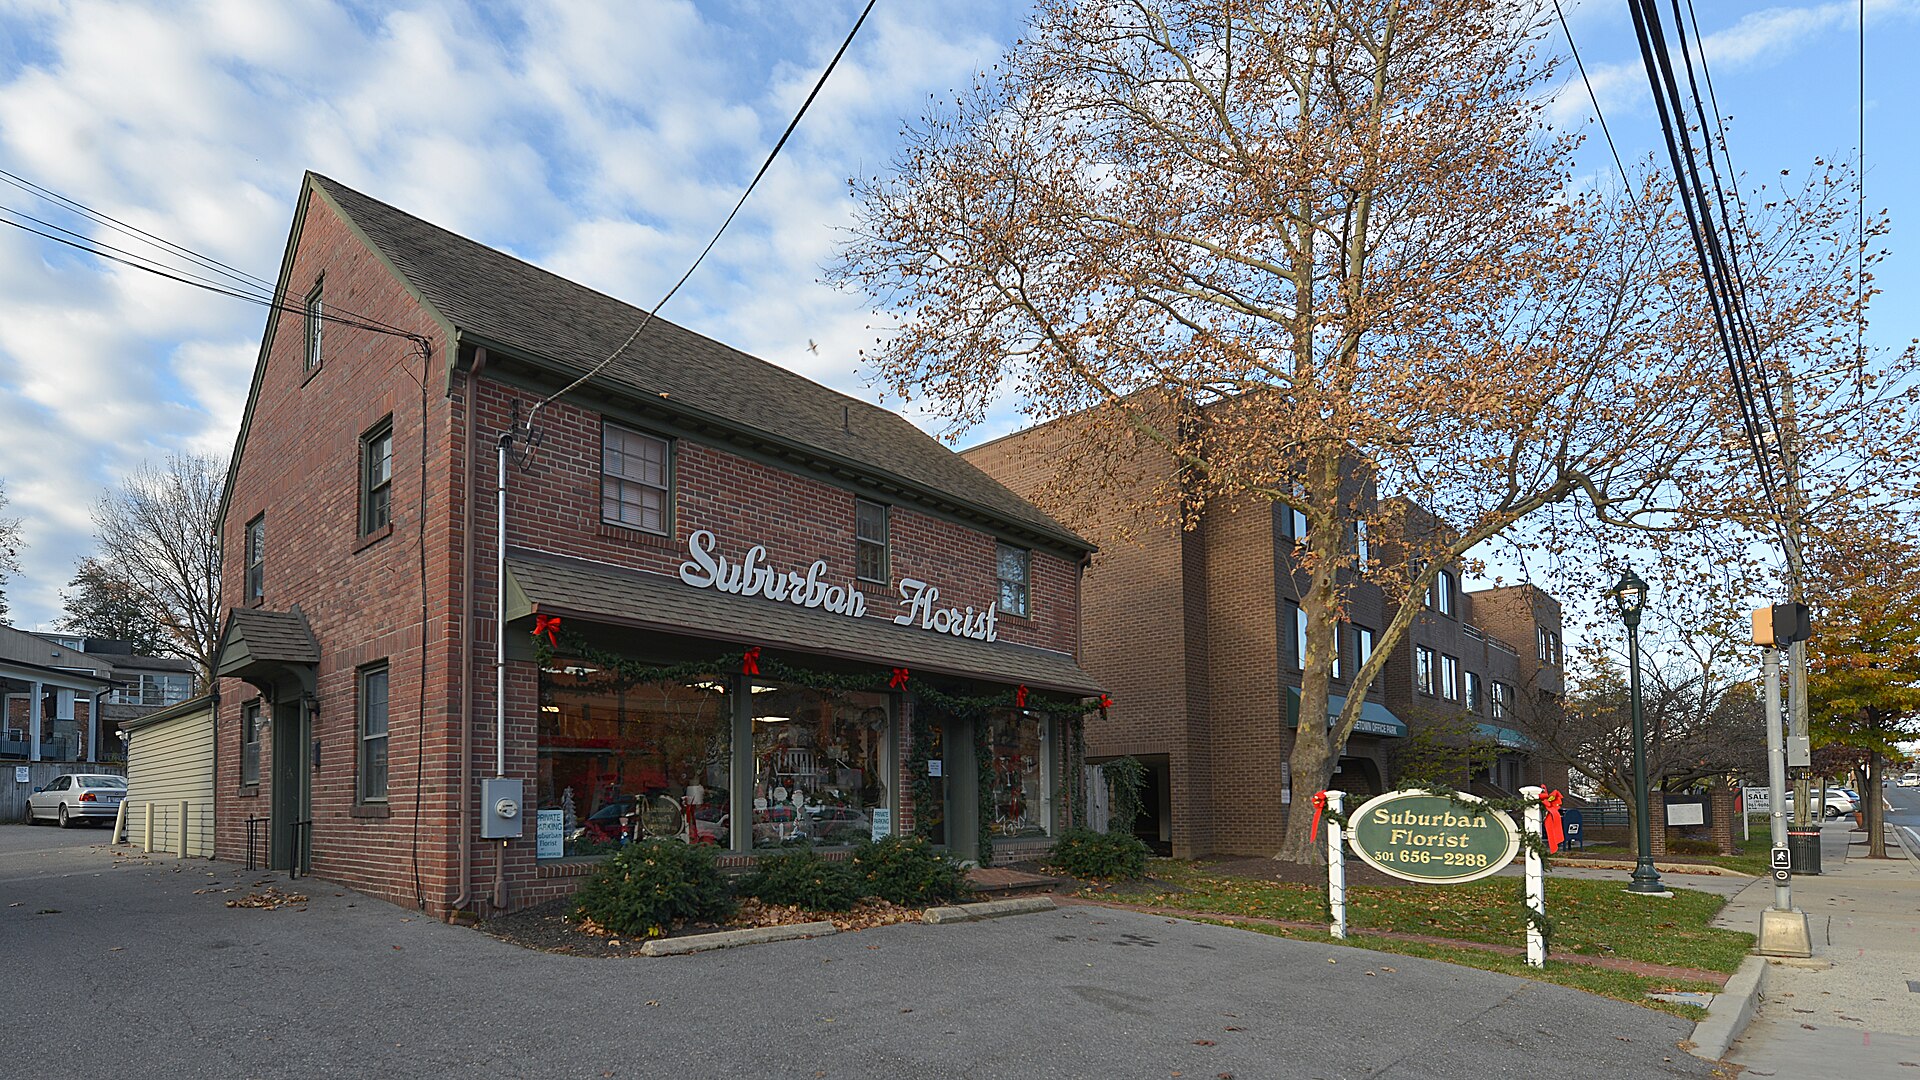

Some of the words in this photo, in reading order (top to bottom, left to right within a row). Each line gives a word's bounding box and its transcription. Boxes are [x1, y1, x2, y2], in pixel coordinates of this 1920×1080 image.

[679, 529, 867, 618] Suburban
[893, 577, 999, 643] Florist
[1372, 722, 1387, 734] OFFICE
[1386, 724, 1398, 735] PARK
[537, 813, 561, 821] PRIVATE
[1372, 808, 1488, 829] Suburban
[1389, 829, 1470, 848] Florist
[1374, 851, 1394, 862] 301
[1399, 849, 1488, 867] 656-2288
